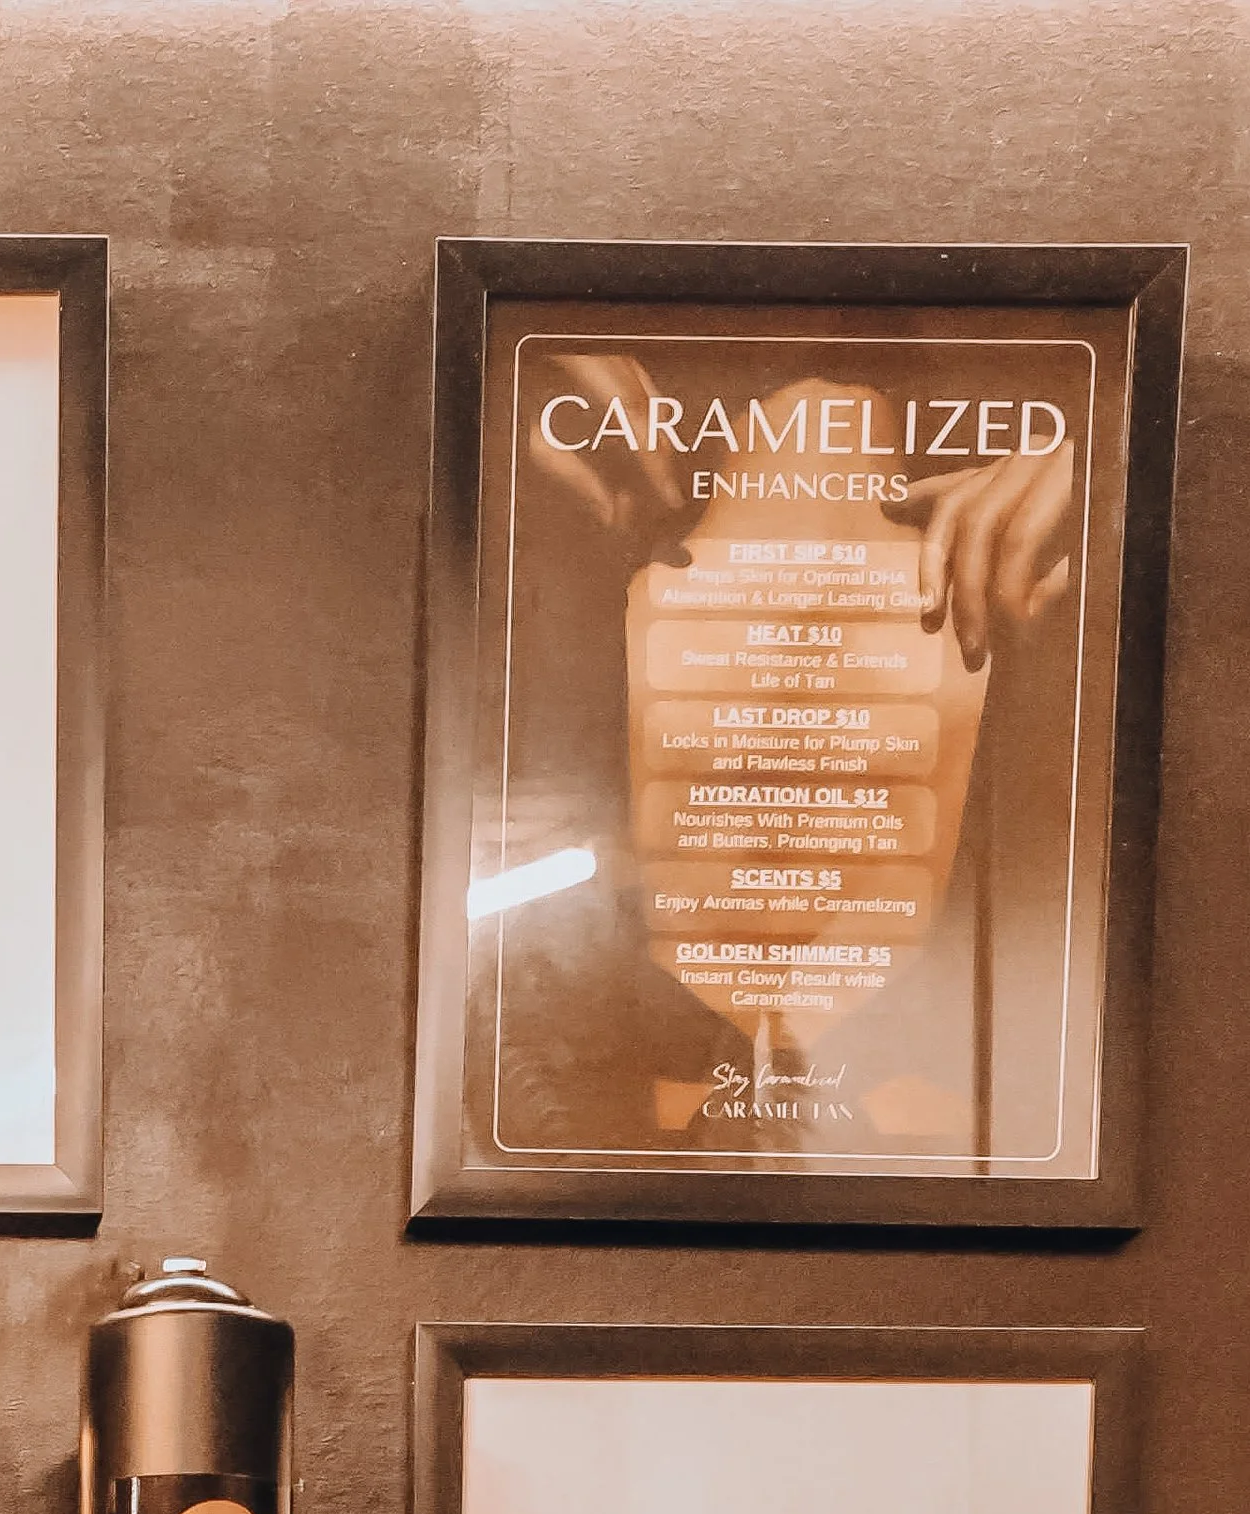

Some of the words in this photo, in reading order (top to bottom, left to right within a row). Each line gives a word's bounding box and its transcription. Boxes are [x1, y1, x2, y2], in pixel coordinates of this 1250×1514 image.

[539, 395, 1066, 456] CARAMELIZED
[692, 470, 909, 502] ENHANCERS
[729, 543, 787, 564] FIRST
[794, 543, 827, 564] SIP
[832, 544, 867, 565] $10
[739, 568, 773, 584] Skin
[777, 568, 799, 584] for
[804, 570, 863, 586] Optimal
[869, 570, 905, 584] DHA
[752, 590, 762, 605] &
[768, 590, 822, 609] Longer
[828, 591, 884, 610] Lasting
[747, 626, 803, 645] HEAT
[808, 626, 843, 646] $10
[681, 651, 730, 667] Sweat
[735, 652, 822, 668] Resistance
[826, 653, 838, 667] &
[843, 652, 907, 669] Extends
[751, 673, 781, 688] Life
[784, 673, 800, 688] of
[805, 674, 835, 688] Tan
[713, 707, 768, 727] LAST
[773, 708, 830, 728] DROP
[835, 709, 870, 729] $10
[662, 734, 708, 749] Locks
[713, 734, 727, 749] in
[732, 734, 799, 750] Moisture
[804, 735, 824, 750] for
[830, 736, 880, 754] Plump
[885, 736, 919, 751] Skin
[713, 755, 742, 769] and
[747, 755, 815, 771] Flawless
[820, 756, 867, 771] Finish
[689, 785, 809, 807] HYDRATION
[815, 787, 844, 807] OIL
[854, 788, 888, 808] $12
[674, 811, 752, 828] Nourishes
[758, 812, 792, 829] With
[797, 813, 867, 830] Premium
[872, 814, 904, 830] Oils
[678, 832, 707, 848] and
[712, 833, 772, 850] Butters,
[777, 834, 862, 853] Prolonging
[868, 835, 897, 850] Tan
[730, 869, 814, 889] SCENTS
[818, 870, 841, 890] $5
[654, 894, 699, 912] Enjoy
[702, 895, 764, 911] Aromas
[768, 896, 809, 911] while
[813, 897, 916, 916] Caramelizing
[676, 944, 763, 964] GOLDEN
[768, 945, 862, 965] SHIMMER
[868, 946, 891, 966] $5
[680, 970, 732, 985] Instant
[737, 970, 786, 988] Glowy
[790, 971, 841, 987] Result
[845, 972, 885, 988] while
[731, 991, 834, 1011] Caramelizing
[702, 1101, 798, 1119] CARAMEL
[813, 1102, 854, 1119] TAN
